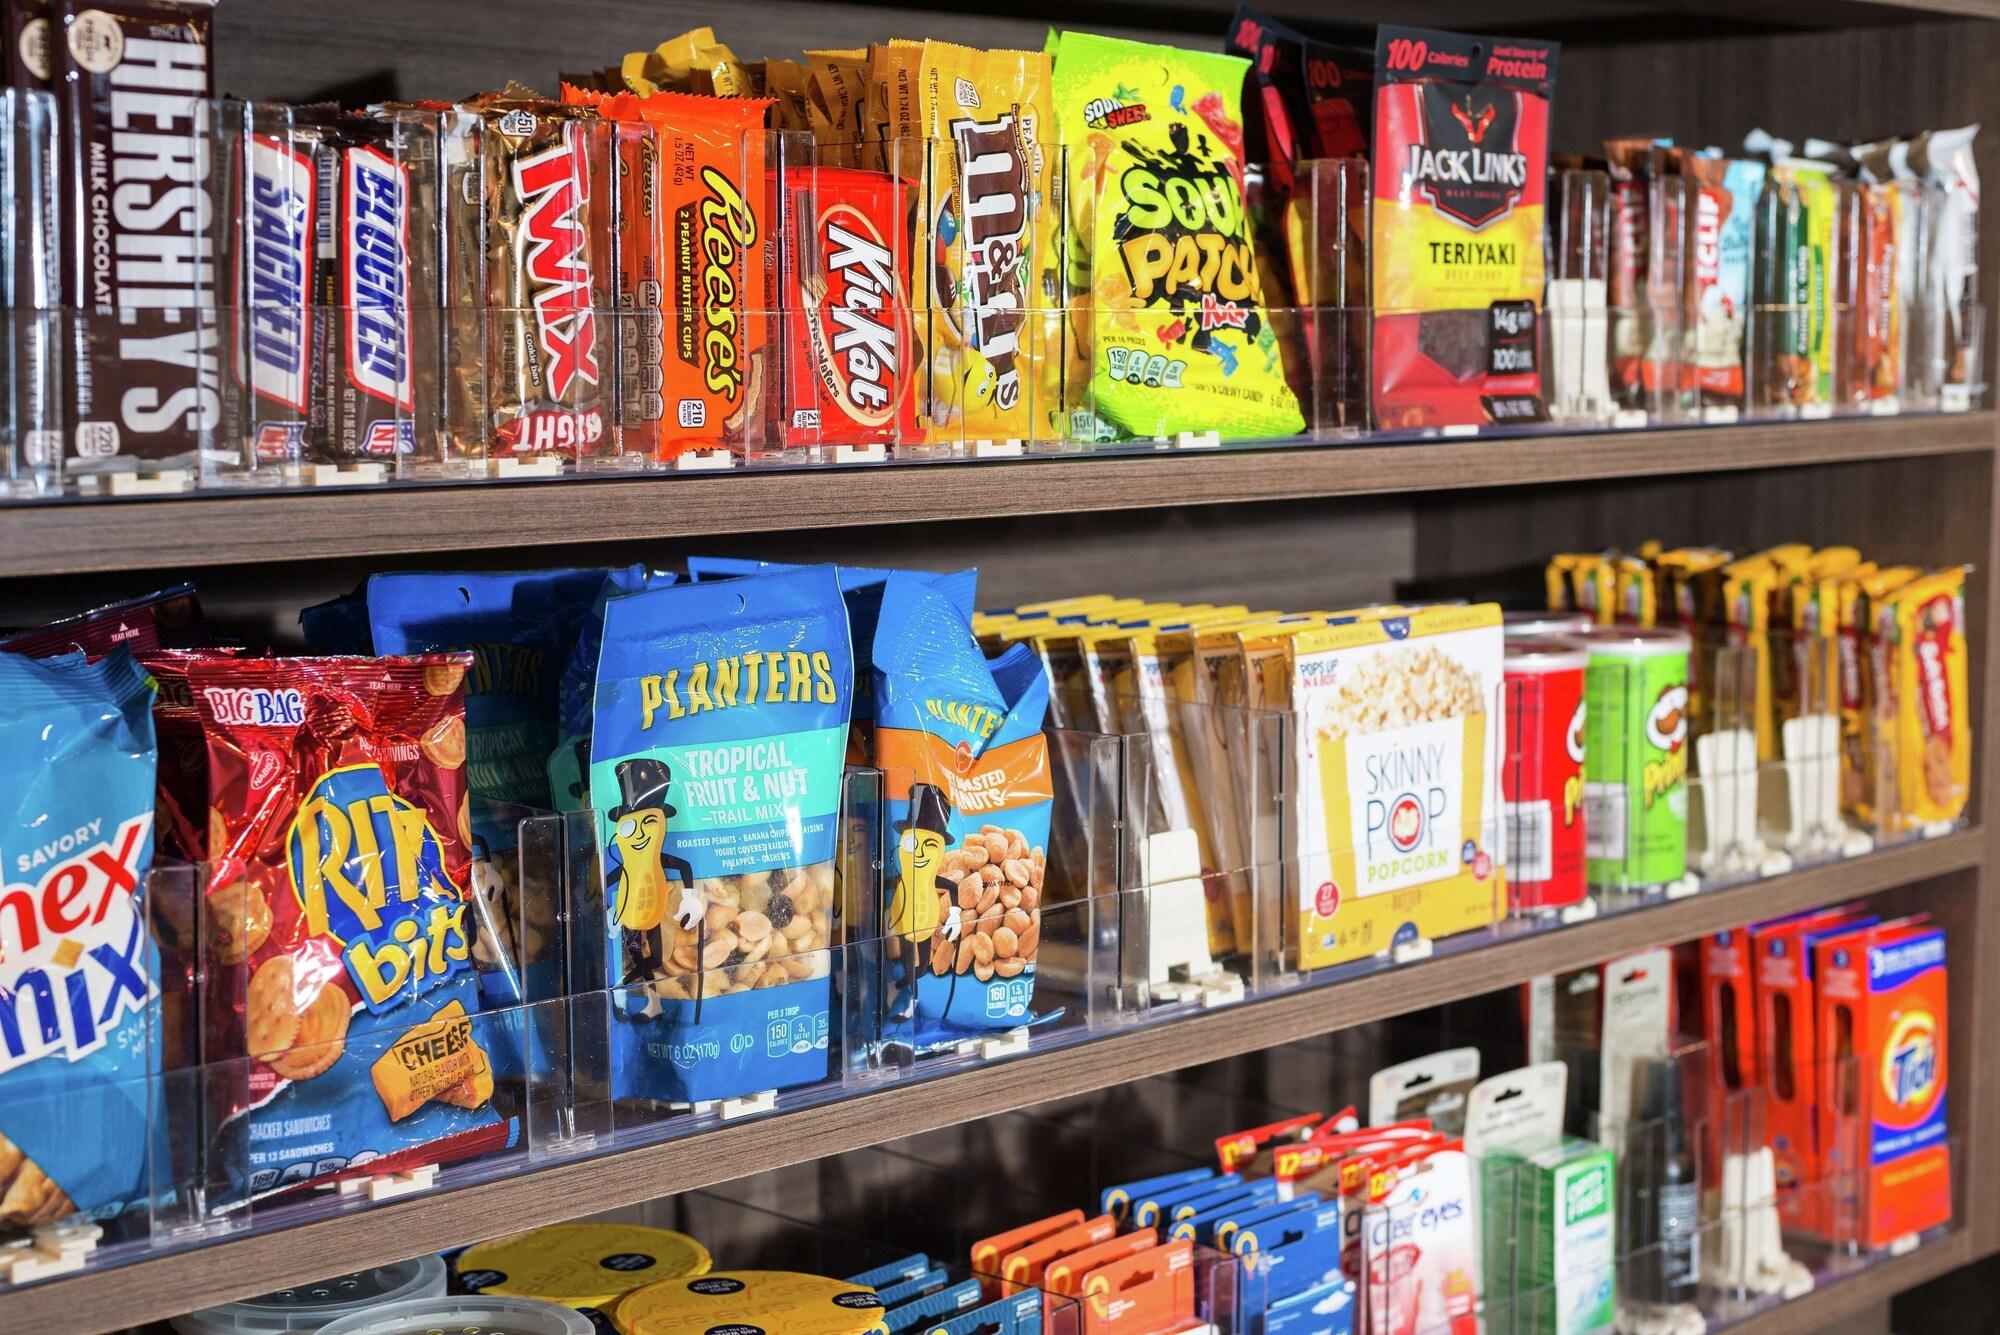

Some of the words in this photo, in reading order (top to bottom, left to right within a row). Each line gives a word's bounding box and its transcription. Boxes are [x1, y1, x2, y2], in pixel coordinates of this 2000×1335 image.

[1386, 37, 1427, 71] 100
[1427, 52, 1470, 68] Calories
[900, 69, 910, 82] NET
[929, 67, 938, 81] NET
[1486, 57, 1547, 80] Protein
[900, 83, 910, 94] WT
[929, 82, 938, 93] WT
[966, 83, 978, 105] 250
[900, 96, 910, 111] 1.74
[929, 95, 938, 109] 1.74
[1084, 98, 1124, 123] SOUR
[900, 112, 910, 122] OZ
[674, 137, 683, 150] 1.5
[685, 142, 694, 162] NET
[91, 142, 108, 191] MILK
[673, 151, 683, 163] OZ
[1409, 144, 1471, 185] JACK
[672, 163, 684, 186] (42g)
[685, 165, 694, 182] WT
[949, 152, 959, 190] CHOCOLATE
[680, 209, 690, 219] 2
[952, 191, 961, 219] CANDIES
[110, 36, 221, 434] HERSHEY'S
[92, 194, 112, 316] CHOCOLATE
[680, 222, 692, 273] PEANUT
[1429, 242, 1516, 266] TERIYAKI
[253, 172, 302, 374] SACKED
[355, 164, 407, 384] BLOCKED
[700, 165, 757, 403] Reese's
[681, 275, 693, 322] BUTTER
[525, 334, 536, 363] cookie
[681, 326, 693, 359] CUPS
[1111, 350, 1127, 364] 150
[1493, 348, 1516, 370] 100
[530, 365, 541, 386] bars
[818, 347, 842, 399] Wafers
[691, 403, 703, 425] 210
[807, 412, 818, 428] 21
[99, 426, 114, 454] 220
[111, 631, 124, 642] TEAR
[125, 628, 140, 640] HERE
[1300, 662, 1325, 676] POPS
[1326, 659, 1339, 674] UP
[369, 680, 386, 691] TEAR
[387, 682, 401, 691] HERE
[640, 651, 838, 730] PLANTERS
[206, 689, 252, 723] BIG
[254, 691, 304, 724] BAG
[685, 741, 793, 777] TROPICAL
[1365, 742, 1446, 794] SKINNY
[253, 754, 277, 789] NABISCO
[685, 776, 737, 808] FRUIT
[743, 775, 761, 802] &
[764, 768, 810, 800] NUT
[710, 807, 752, 826] TRAIL
[756, 803, 783, 820] MIX
[1366, 788, 1446, 861] POP
[16, 817, 103, 872] SAVORY
[677, 838, 711, 849] ROASTED
[712, 835, 737, 846] PEANUTS
[743, 831, 770, 843] BANANA
[801, 823, 824, 835] AISINS
[714, 846, 737, 857] YOGURT
[737, 844, 767, 856] COVERED
[767, 839, 794, 851] RAISINS
[302, 794, 428, 936] RIT
[722, 856, 756, 869] PINEAPPLE
[761, 851, 791, 864] CASHEWS
[1367, 849, 1449, 883] POPCORN
[349, 903, 469, 1006] bits
[990, 986, 1006, 1002] 160
[768, 1010, 779, 1020] PER
[785, 1006, 800, 1017] TBSP
[771, 1023, 787, 1039] 150
[401, 1021, 470, 1071] CHEESE
[648, 1042, 660, 1056] NET
[661, 1043, 674, 1056] WT
[675, 1046, 681, 1060] 6
[683, 1044, 696, 1059] OZ
[697, 1040, 720, 1061] (170g)
[409, 1067, 435, 1088] NATURAL
[435, 1058, 459, 1078] FLAVOR
[409, 1084, 430, 1102] OTHER
[284, 1114, 332, 1137] SANDWICHES
[268, 1151, 278, 1162] 13
[279, 1143, 334, 1161] SANDWICHES
[1421, 1199, 1463, 1231] eyes
